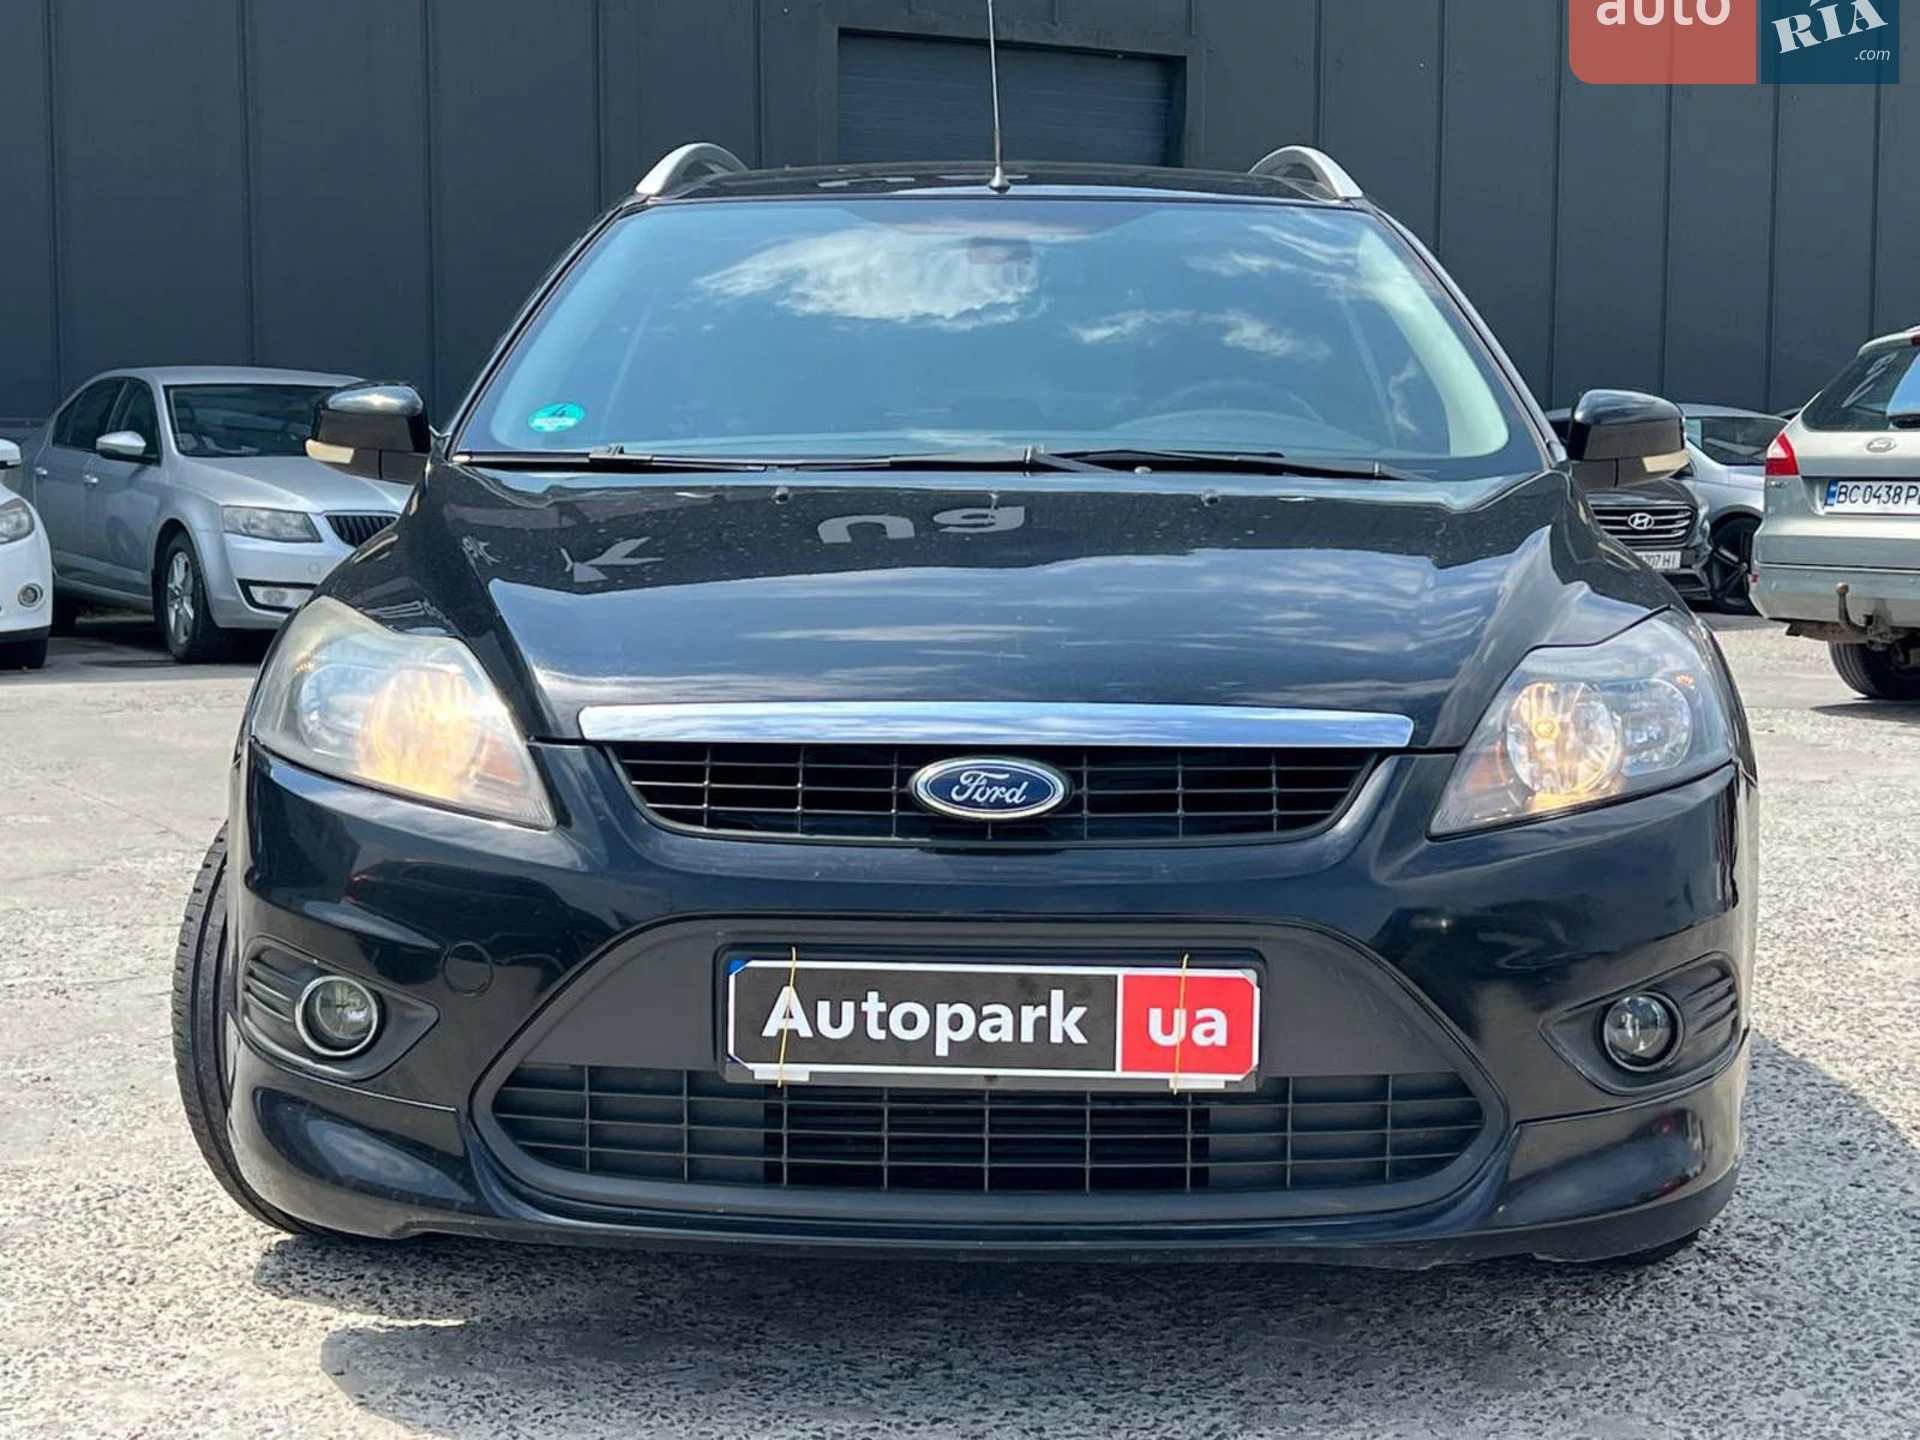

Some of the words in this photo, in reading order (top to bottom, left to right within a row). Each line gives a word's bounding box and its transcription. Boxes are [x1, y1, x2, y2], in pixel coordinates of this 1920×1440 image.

[1905, 485, 1920, 505] P
[950, 770, 1029, 804] Ford
[761, 986, 1089, 1057] Autopark
[1147, 1006, 1228, 1047] ua
